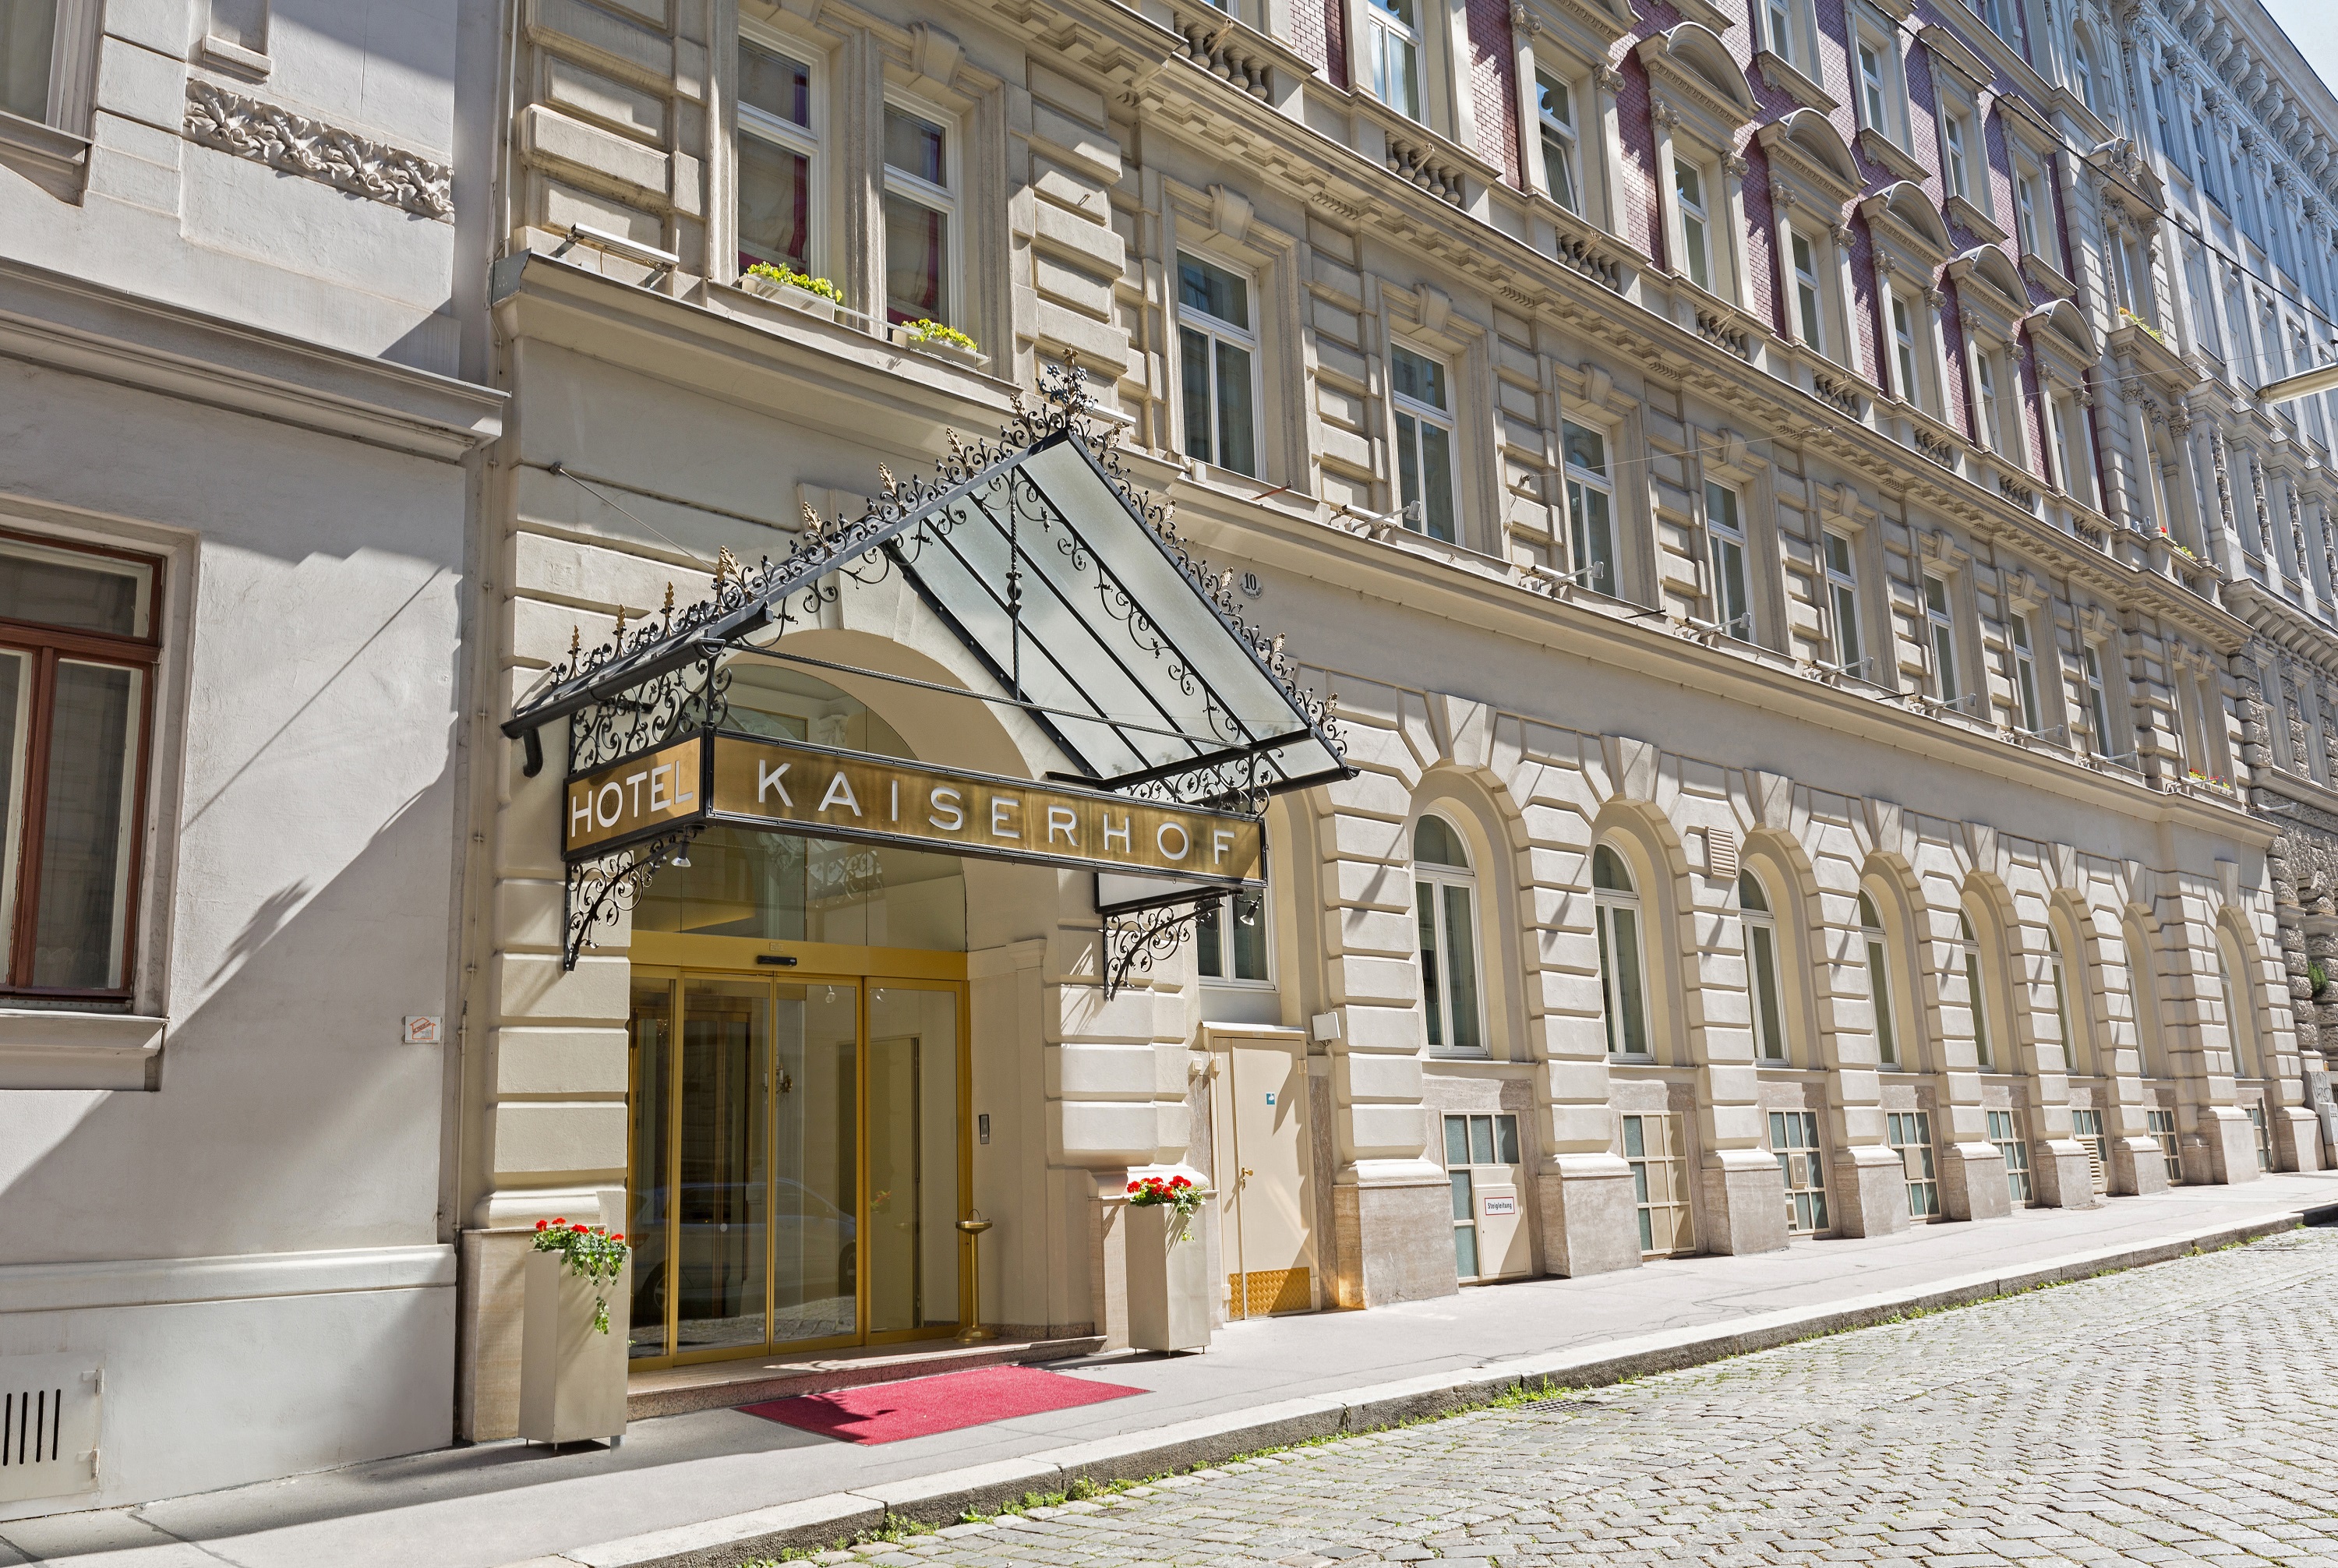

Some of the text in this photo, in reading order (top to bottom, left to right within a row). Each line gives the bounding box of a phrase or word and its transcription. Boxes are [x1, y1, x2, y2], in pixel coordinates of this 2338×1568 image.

[1245, 573, 1256, 590] 10
[571, 761, 693, 838] HOTEL
[758, 759, 1235, 865] KAISERHOF
